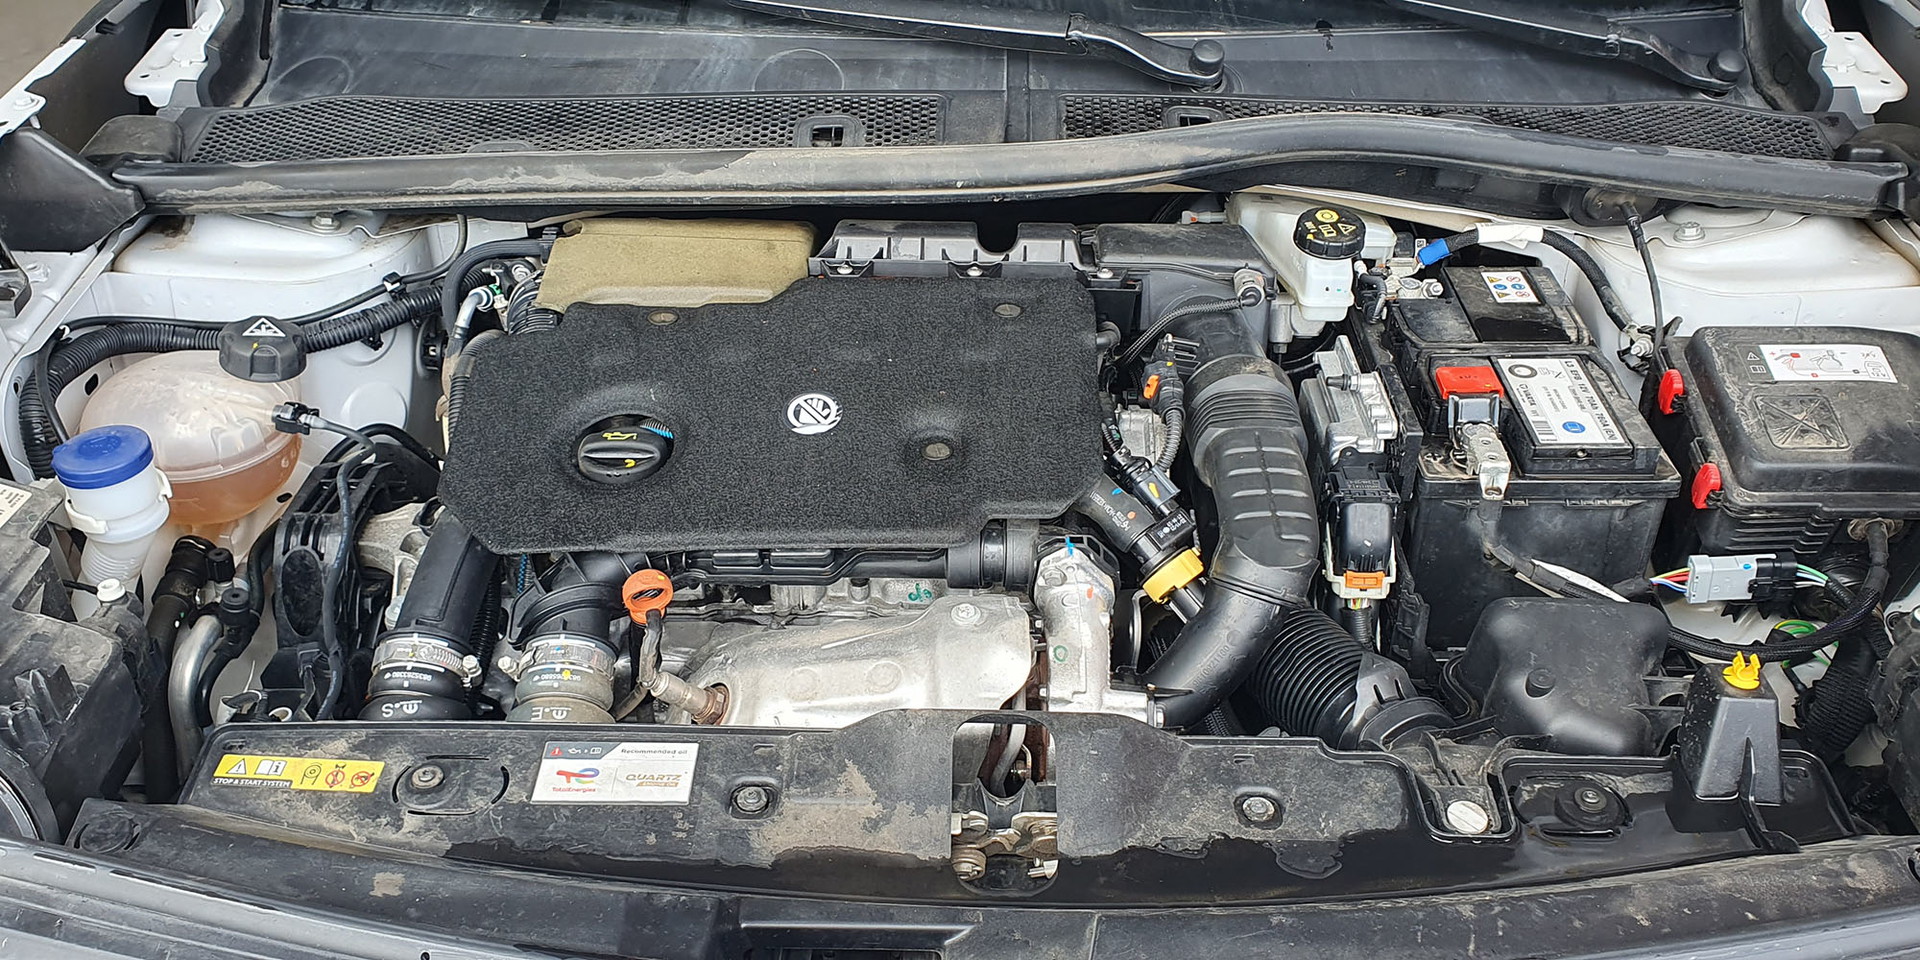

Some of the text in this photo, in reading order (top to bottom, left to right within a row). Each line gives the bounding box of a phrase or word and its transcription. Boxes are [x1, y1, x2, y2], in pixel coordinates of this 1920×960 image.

[213, 777, 234, 785] STOP
[240, 779, 262, 787] START
[262, 780, 291, 788] SYSTEM
